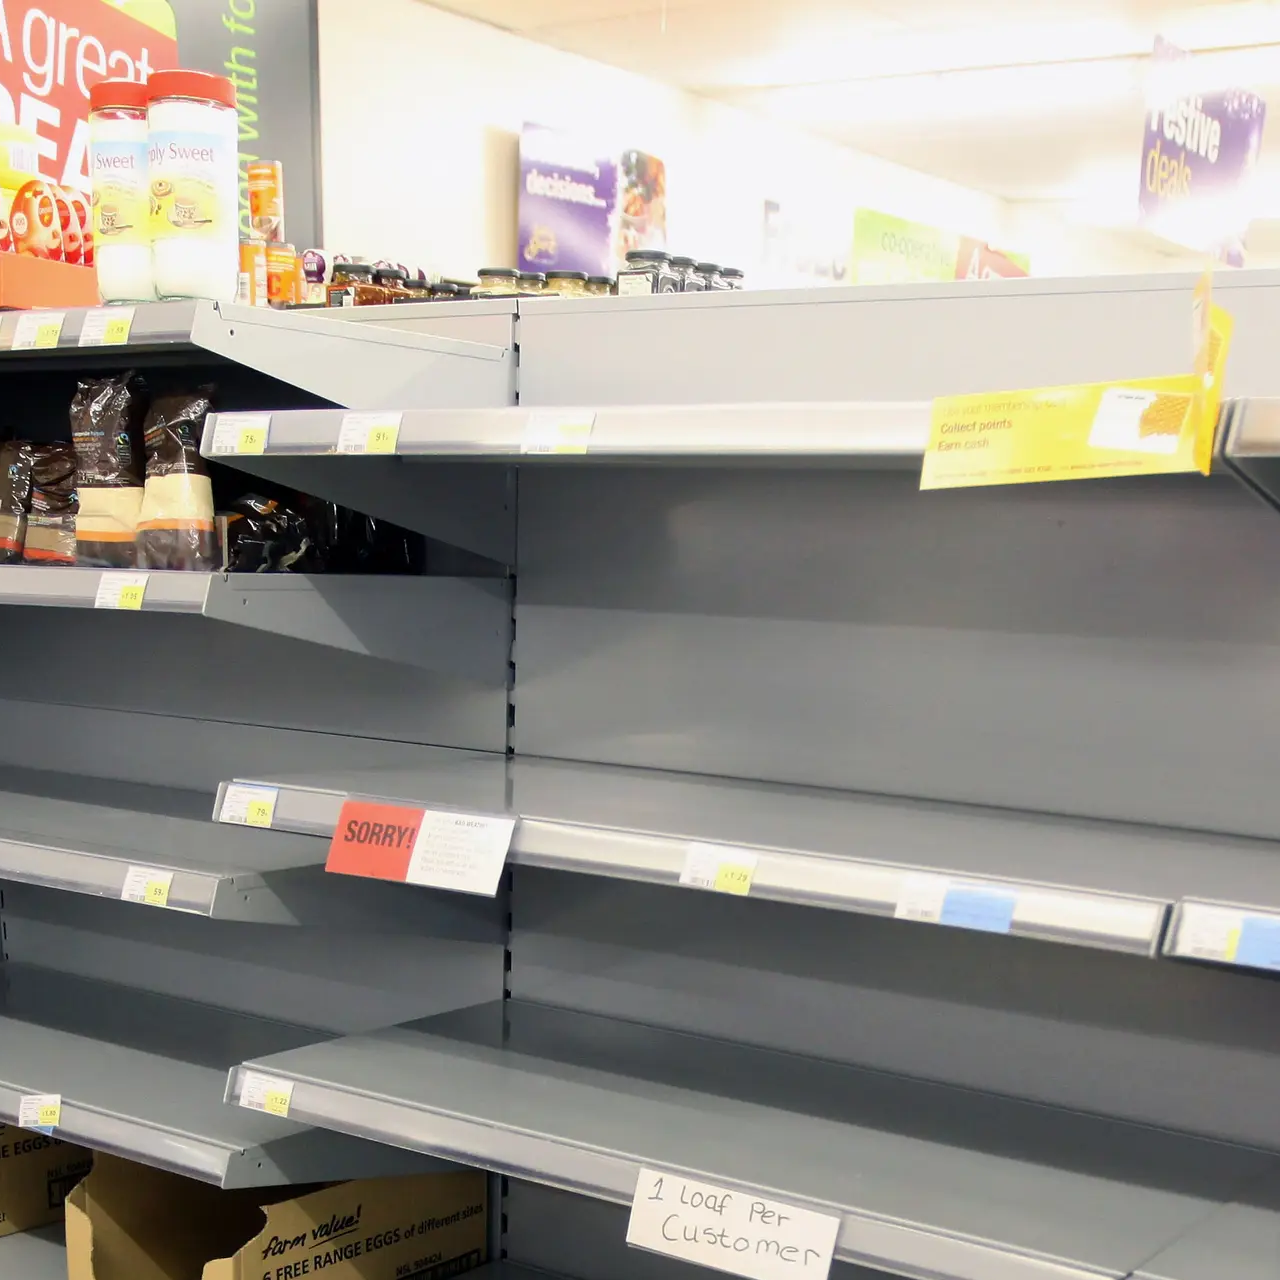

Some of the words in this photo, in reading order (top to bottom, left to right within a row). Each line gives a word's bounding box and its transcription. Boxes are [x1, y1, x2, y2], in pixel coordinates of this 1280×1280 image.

[96, 153, 135, 170] Sweet
[169, 143, 215, 163] Sweet
[940, 421, 977, 435] Collect
[979, 418, 1013, 432] points
[938, 440, 962, 452] Earn
[964, 438, 990, 450] cash
[343, 818, 417, 851] SORRY!
[14, 1134, 52, 1157] EGGS
[646, 1176, 665, 1201] 1
[262, 1231, 308, 1261] farm
[311, 1203, 363, 1241] value!
[313, 1240, 363, 1270] RANGE
[366, 1227, 401, 1253] EGGS
[404, 1223, 416, 1241] of
[418, 1212, 461, 1236] different
[661, 1212, 821, 1267] Customer
